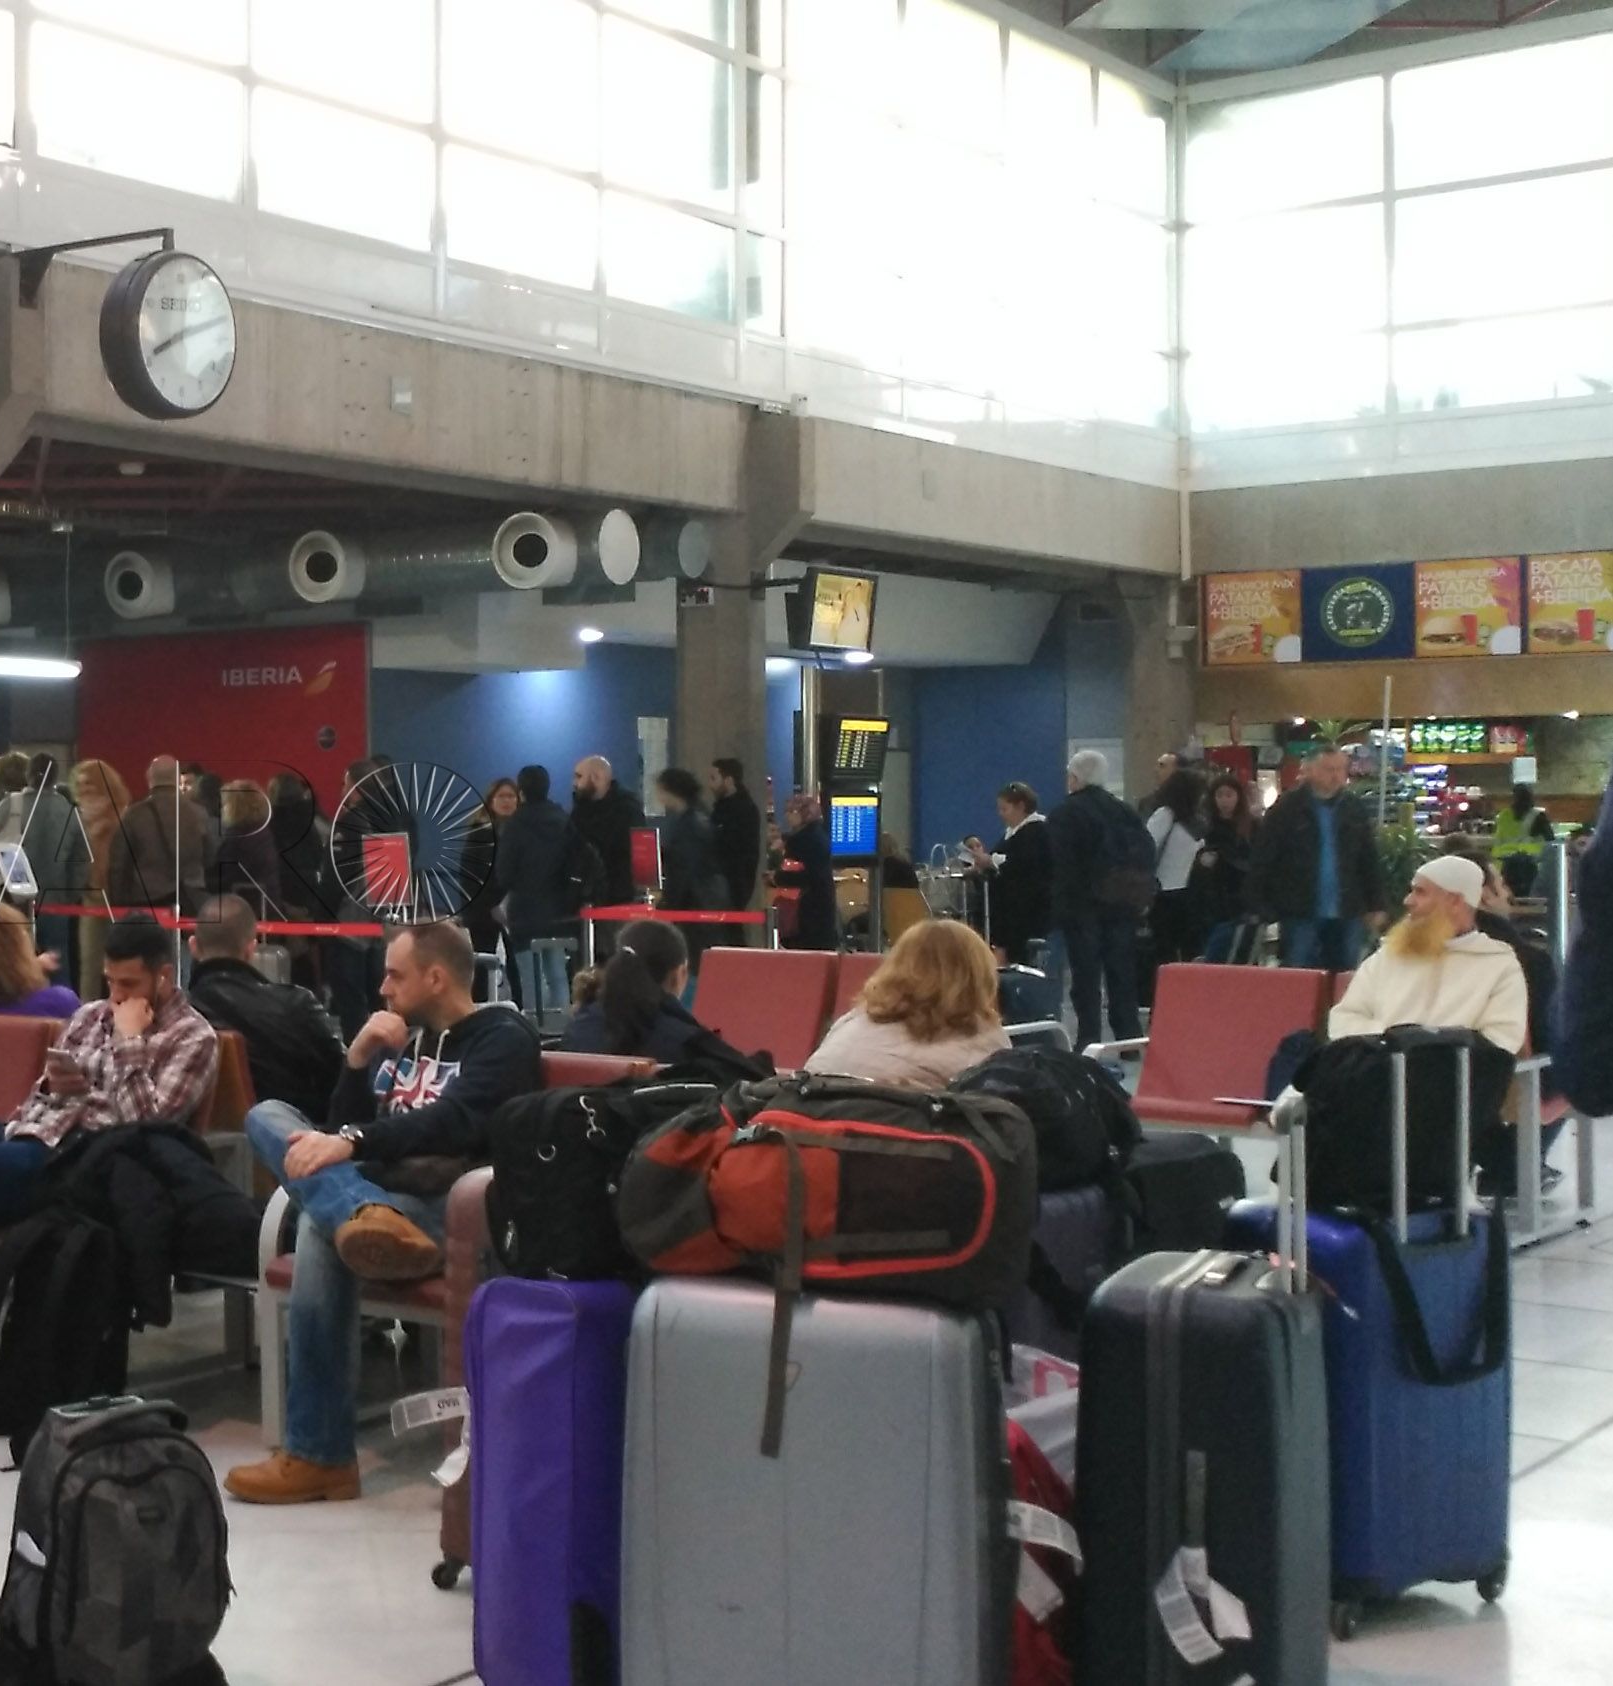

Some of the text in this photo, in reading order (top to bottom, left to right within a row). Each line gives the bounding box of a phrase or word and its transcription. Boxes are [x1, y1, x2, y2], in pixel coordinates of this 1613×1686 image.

[1530, 558, 1603, 575] BOCATA
[1418, 578, 1488, 595] PATATAS
[1530, 573, 1604, 590] PATATAS
[1209, 590, 1272, 605] PATATAS
[1419, 593, 1498, 610] +BEBIDA
[1531, 588, 1613, 605] +BEBIDA
[1210, 604, 1281, 621] +BEBIDA
[221, 666, 302, 687] IBERIA
[437, 1398, 460, 1410] MAD
